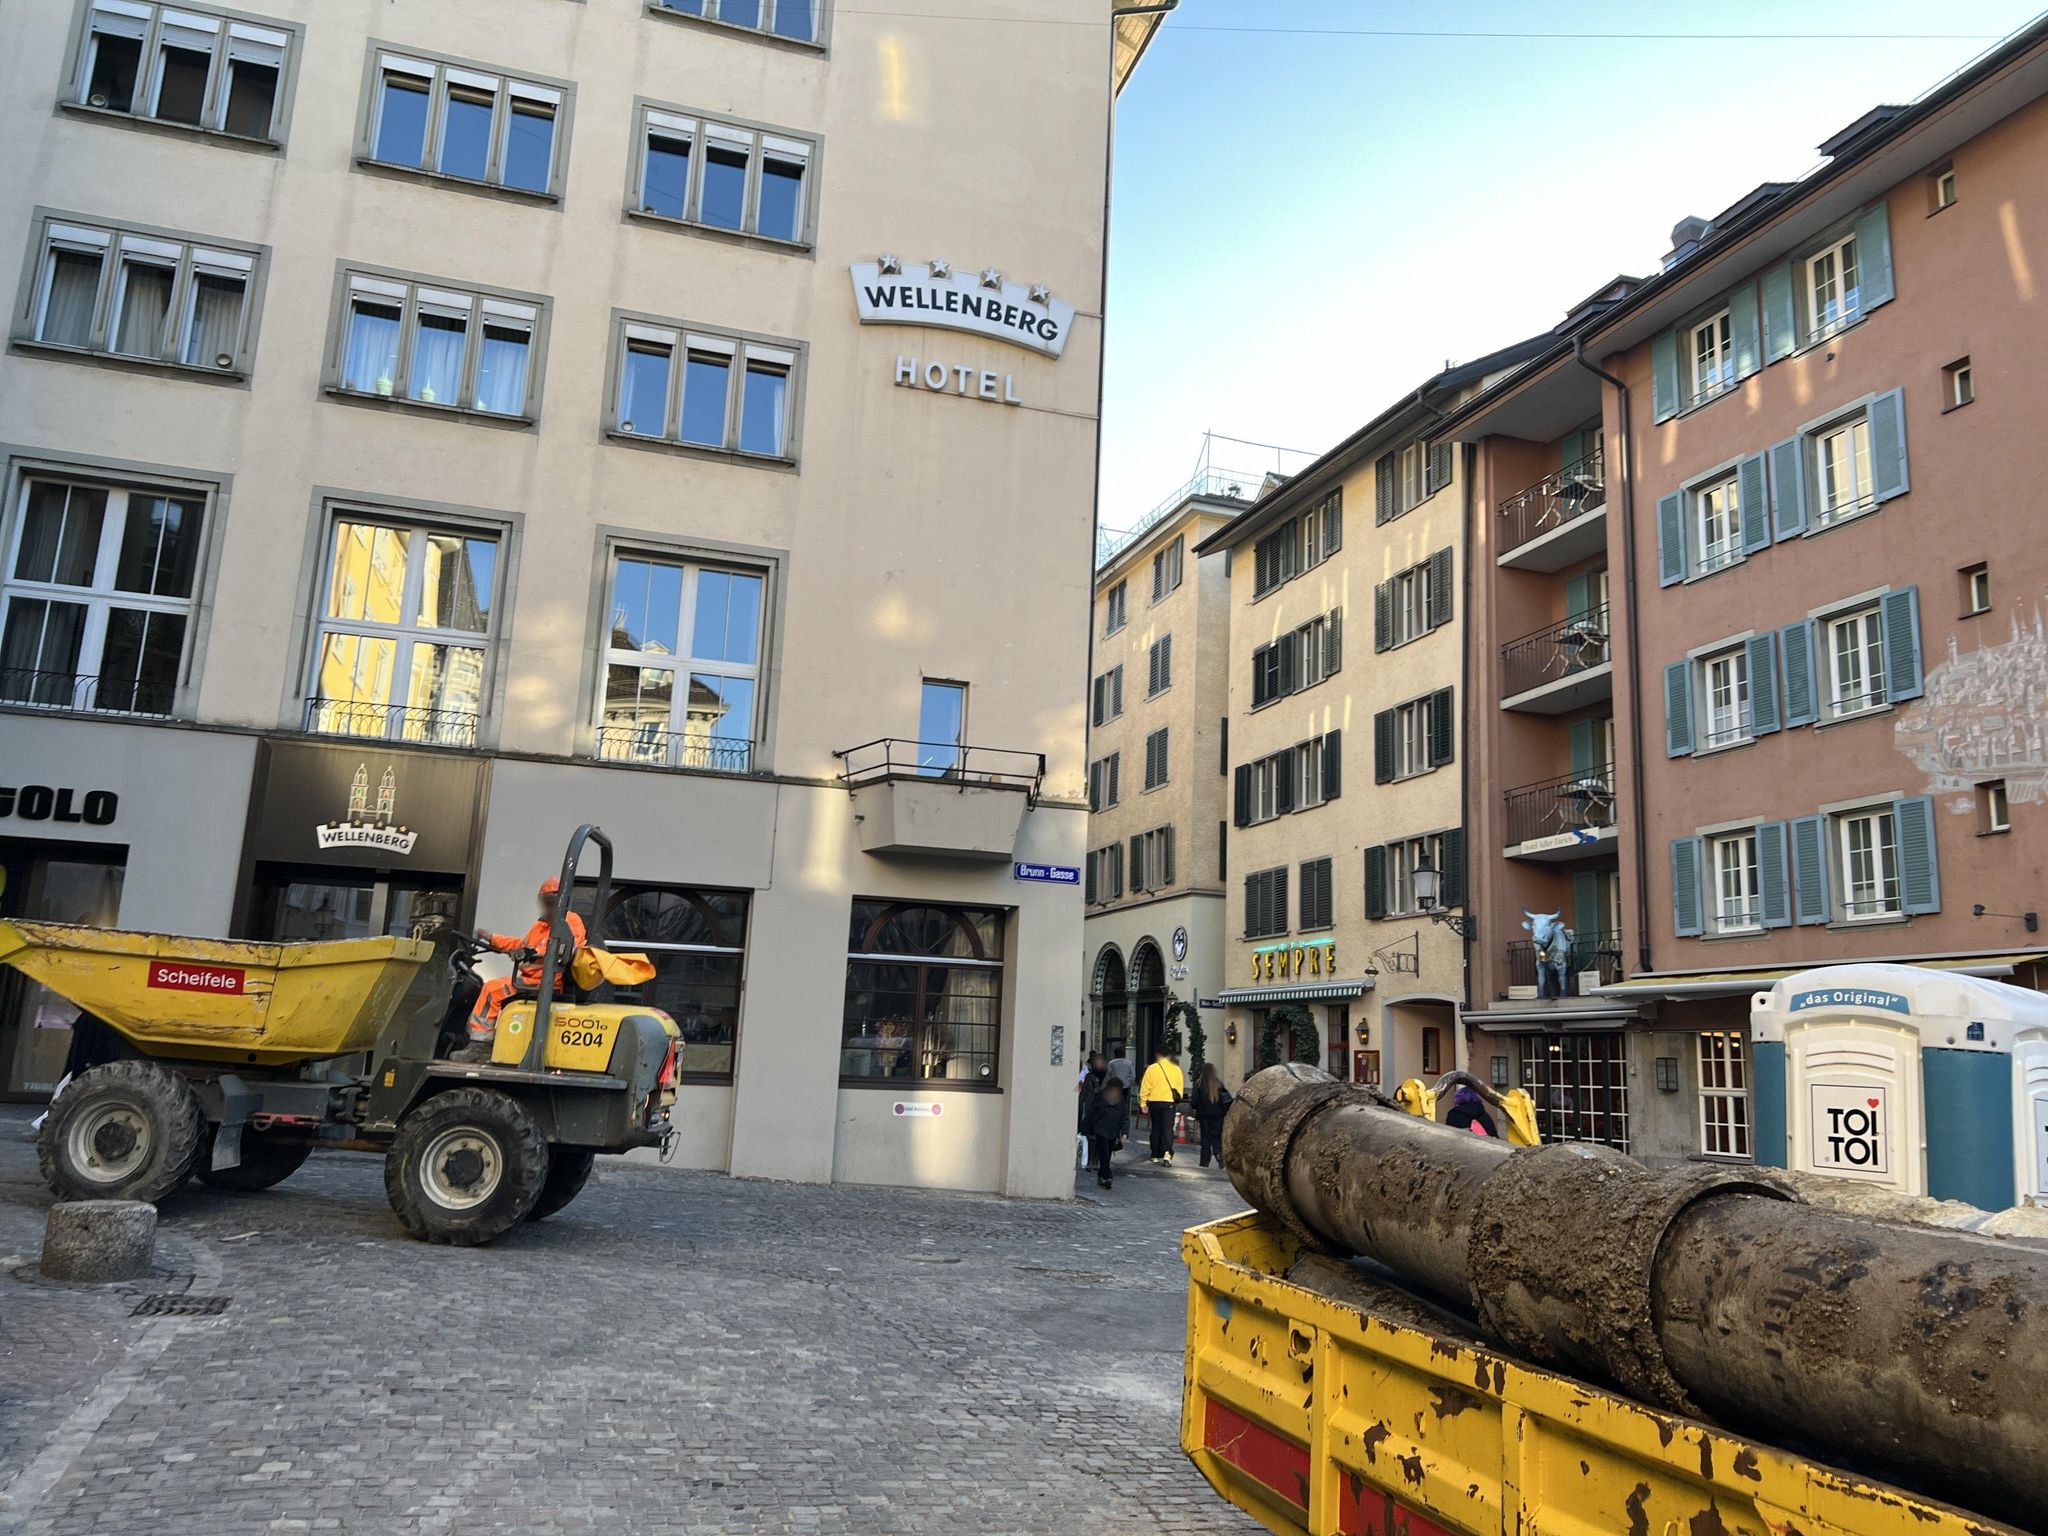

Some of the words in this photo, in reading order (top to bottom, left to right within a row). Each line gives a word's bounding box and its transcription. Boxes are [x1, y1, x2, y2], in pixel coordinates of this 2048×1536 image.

[864, 285, 1058, 341] WELLENBERG
[894, 355, 1022, 406] HOTEL
[323, 831, 410, 849] WELLENBERG
[1251, 944, 1335, 980] SEMPRE
[157, 968, 237, 989] Scheifele
[561, 1030, 603, 1048] 6204
[1827, 1107, 1877, 1137] TOI
[1828, 1136, 1878, 1166] TOI
